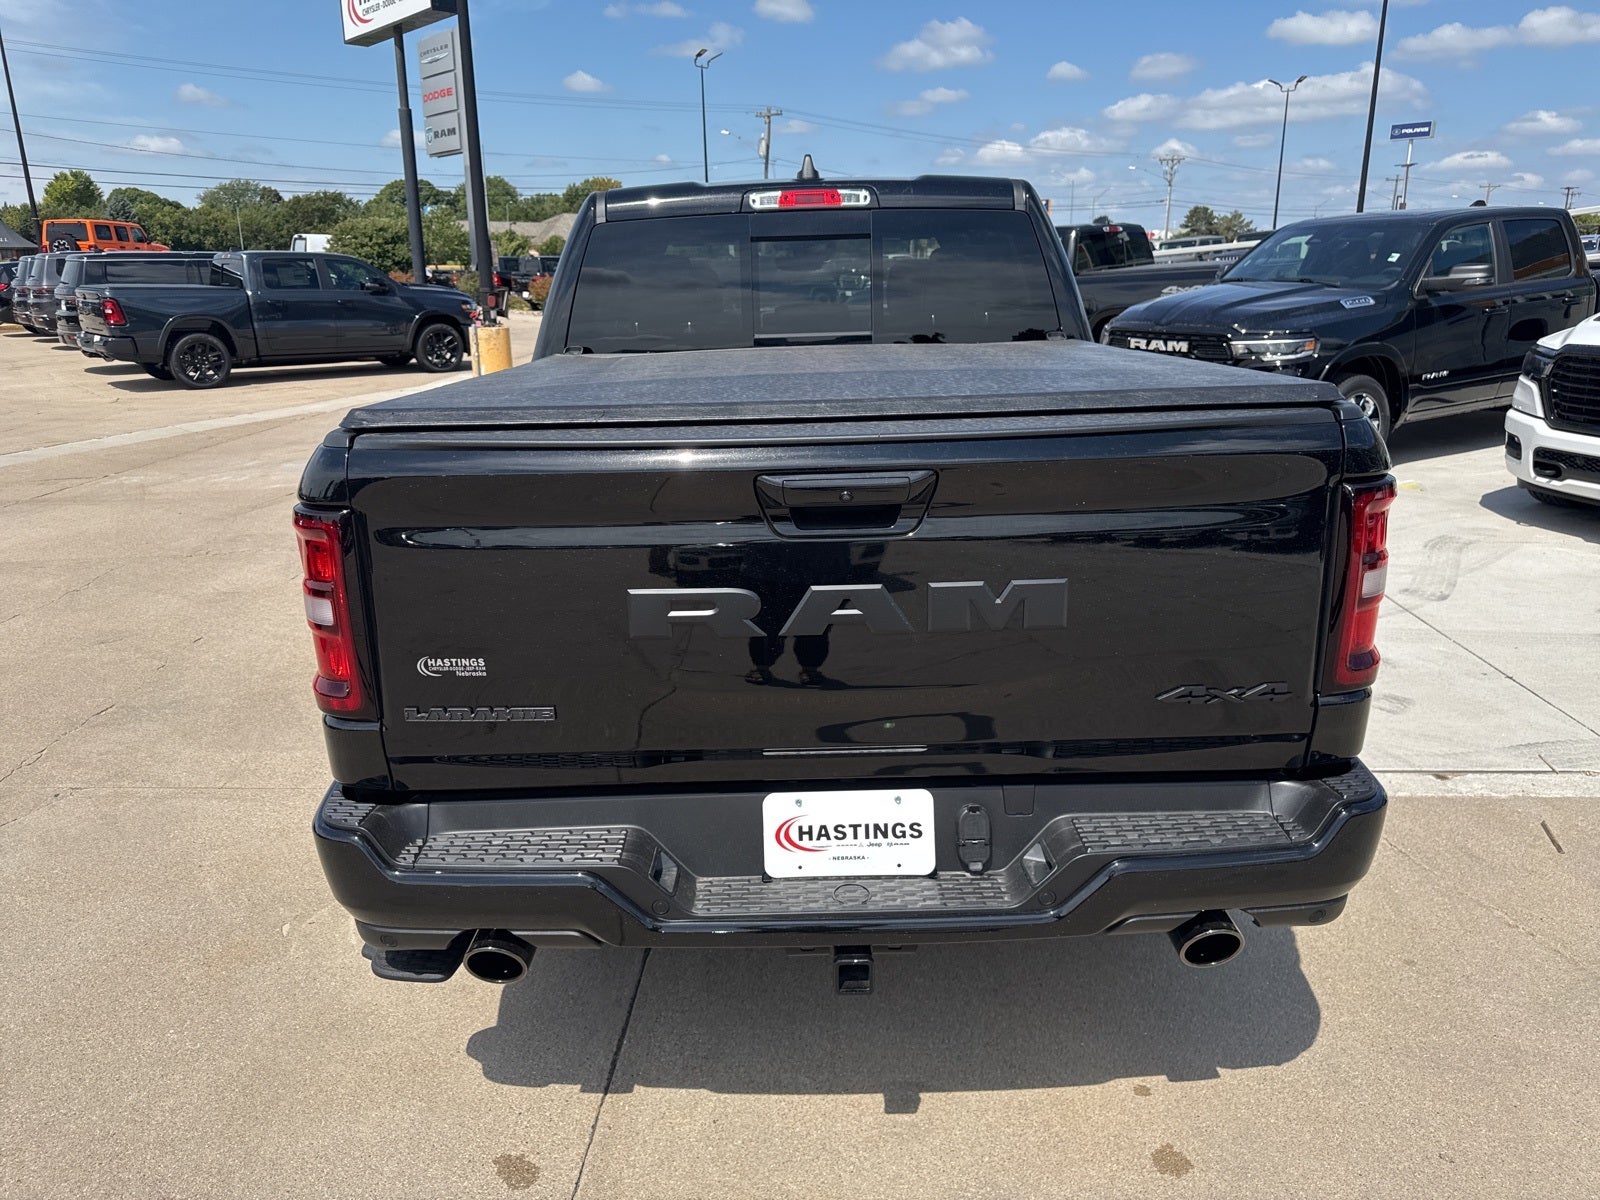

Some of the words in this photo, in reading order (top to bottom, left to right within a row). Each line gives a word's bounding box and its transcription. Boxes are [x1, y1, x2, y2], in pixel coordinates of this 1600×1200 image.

[362, 3, 380, 16] CHRYSLER
[420, 44, 449, 57] CHRYSLER
[423, 87, 453, 102] DODGE
[433, 127, 457, 139] RAM
[1129, 338, 1189, 353] RAM
[627, 578, 1068, 637] RAM
[427, 658, 485, 667] HASTINGS
[404, 706, 555, 722] LARAMIE
[798, 822, 923, 841] HASTINGS
